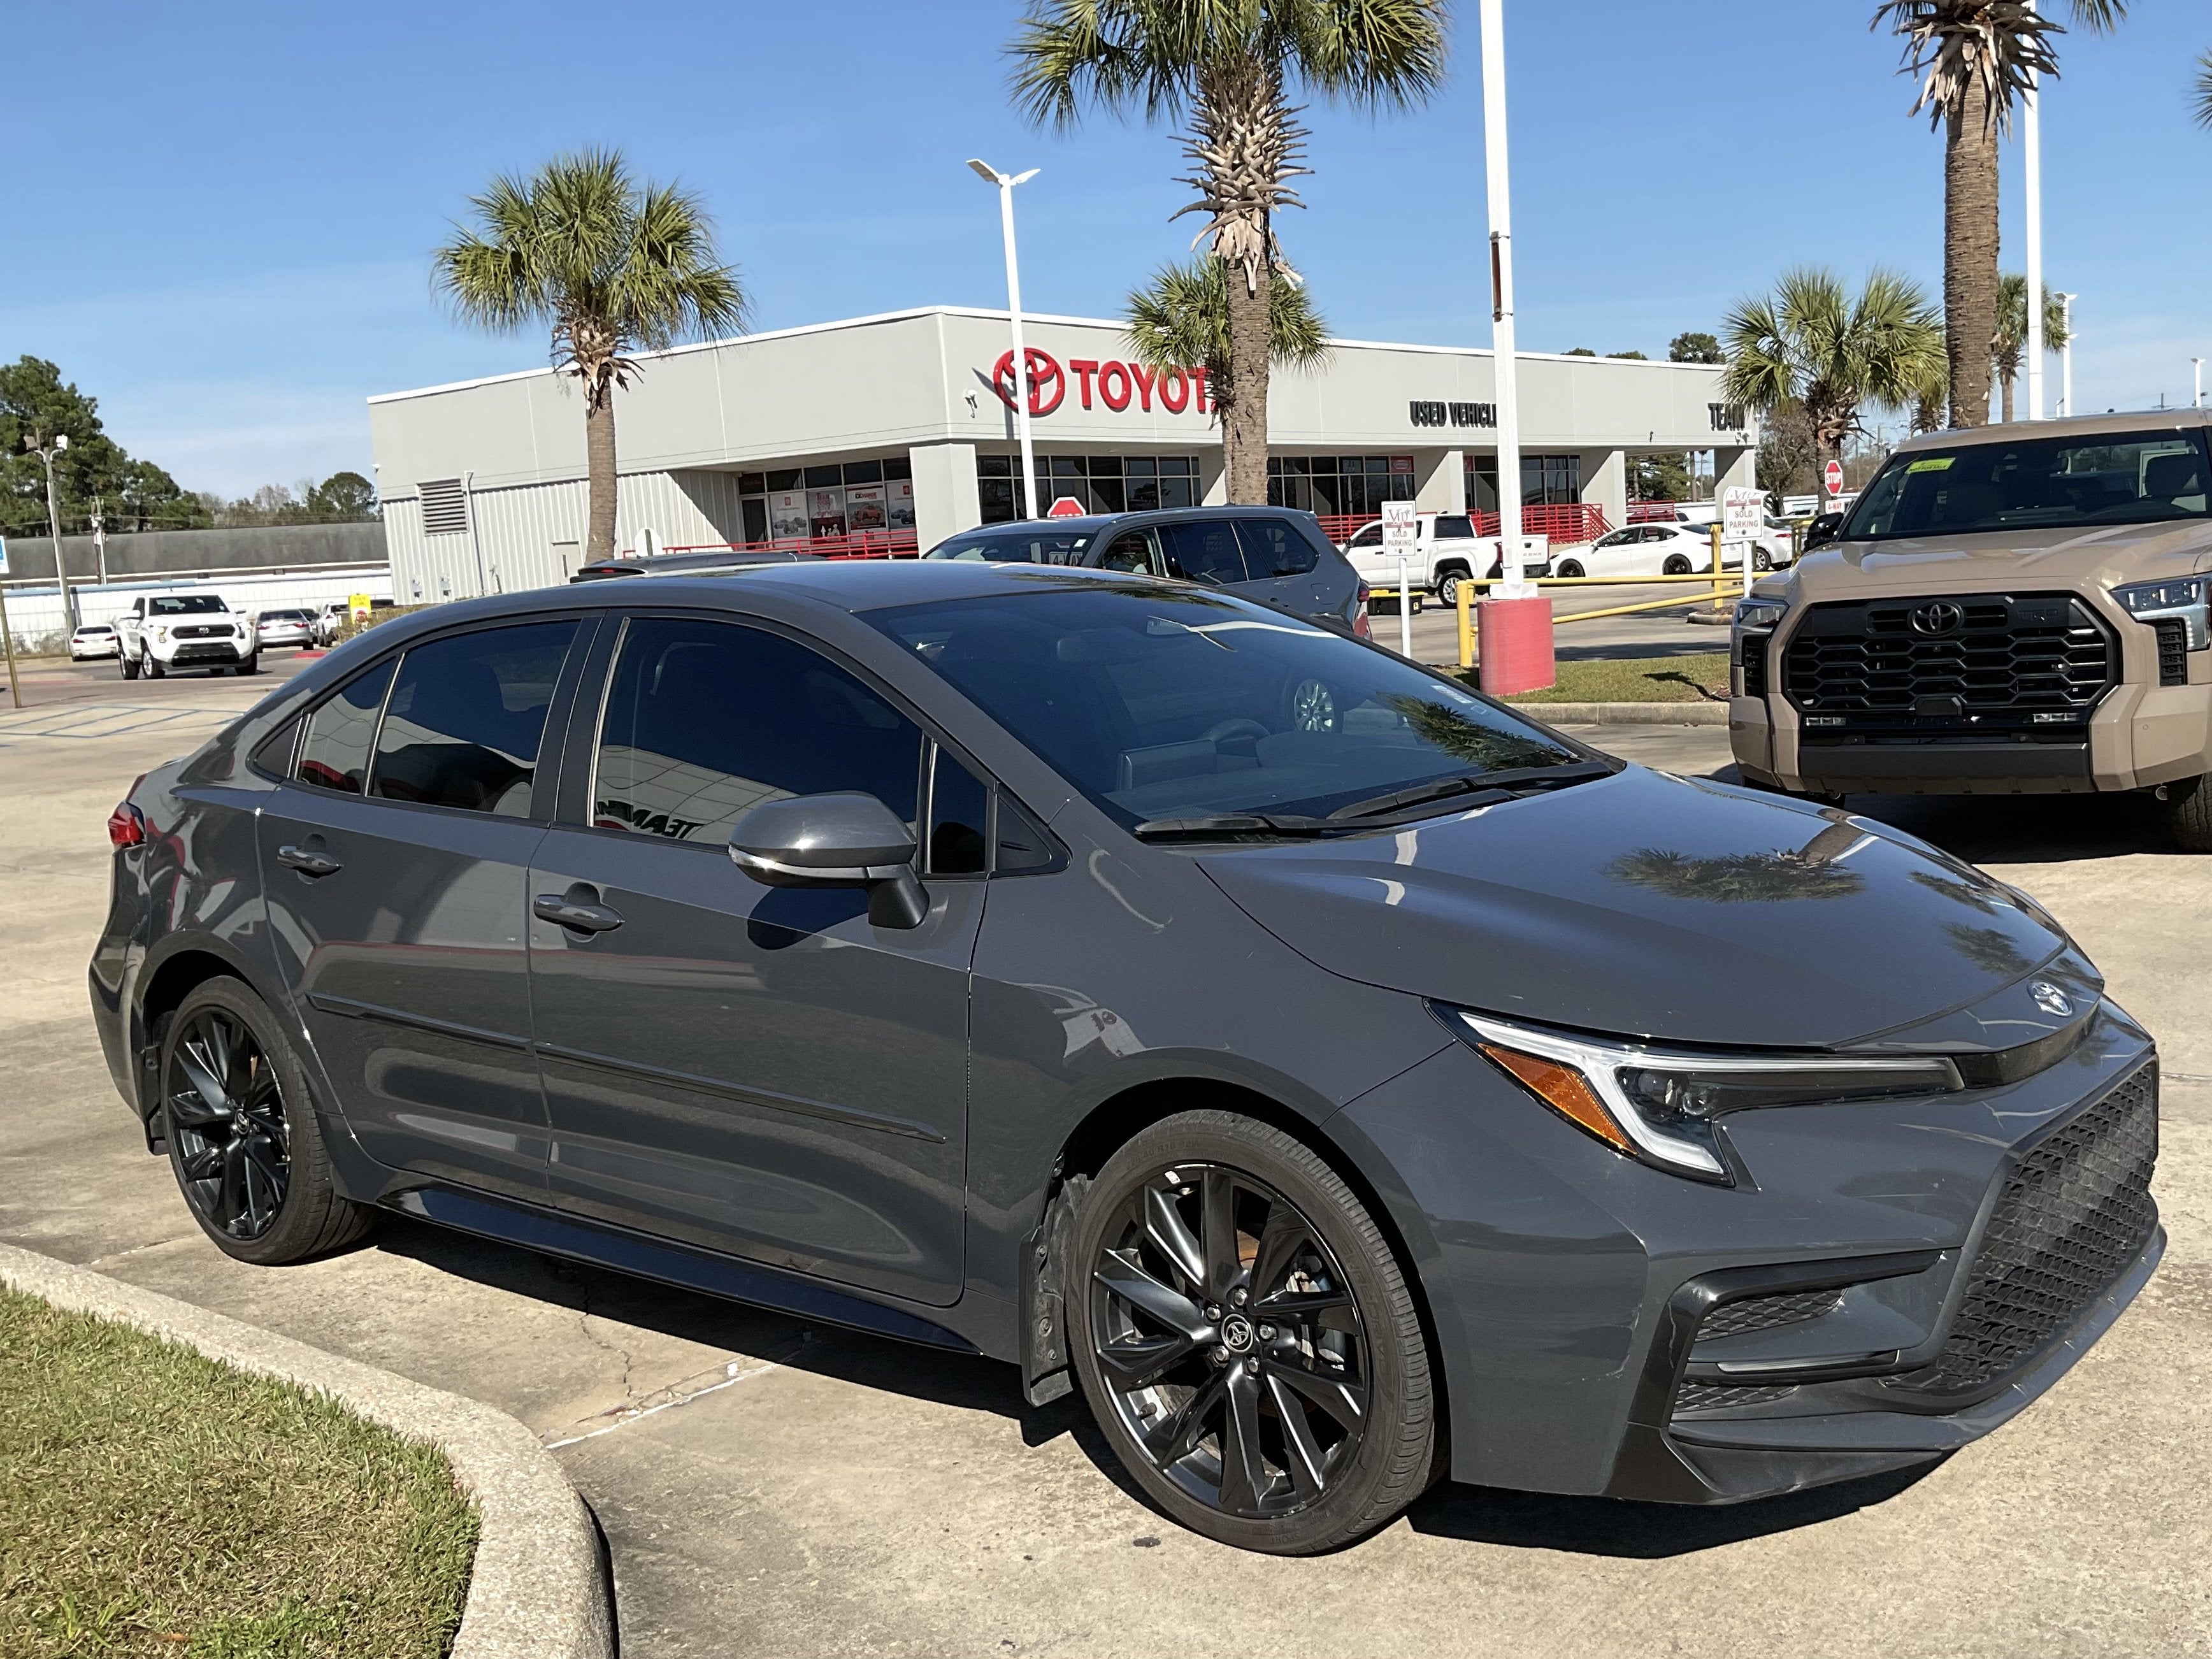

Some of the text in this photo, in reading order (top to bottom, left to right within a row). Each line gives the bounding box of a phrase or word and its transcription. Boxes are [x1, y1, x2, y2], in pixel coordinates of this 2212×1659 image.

[1069, 359, 1219, 415] TOYOT
[1409, 401, 1447, 427] USED
[1707, 403, 1745, 431] TEAM
[1826, 472, 1841, 485] STOP
[1729, 520, 1758, 528] PARKING
